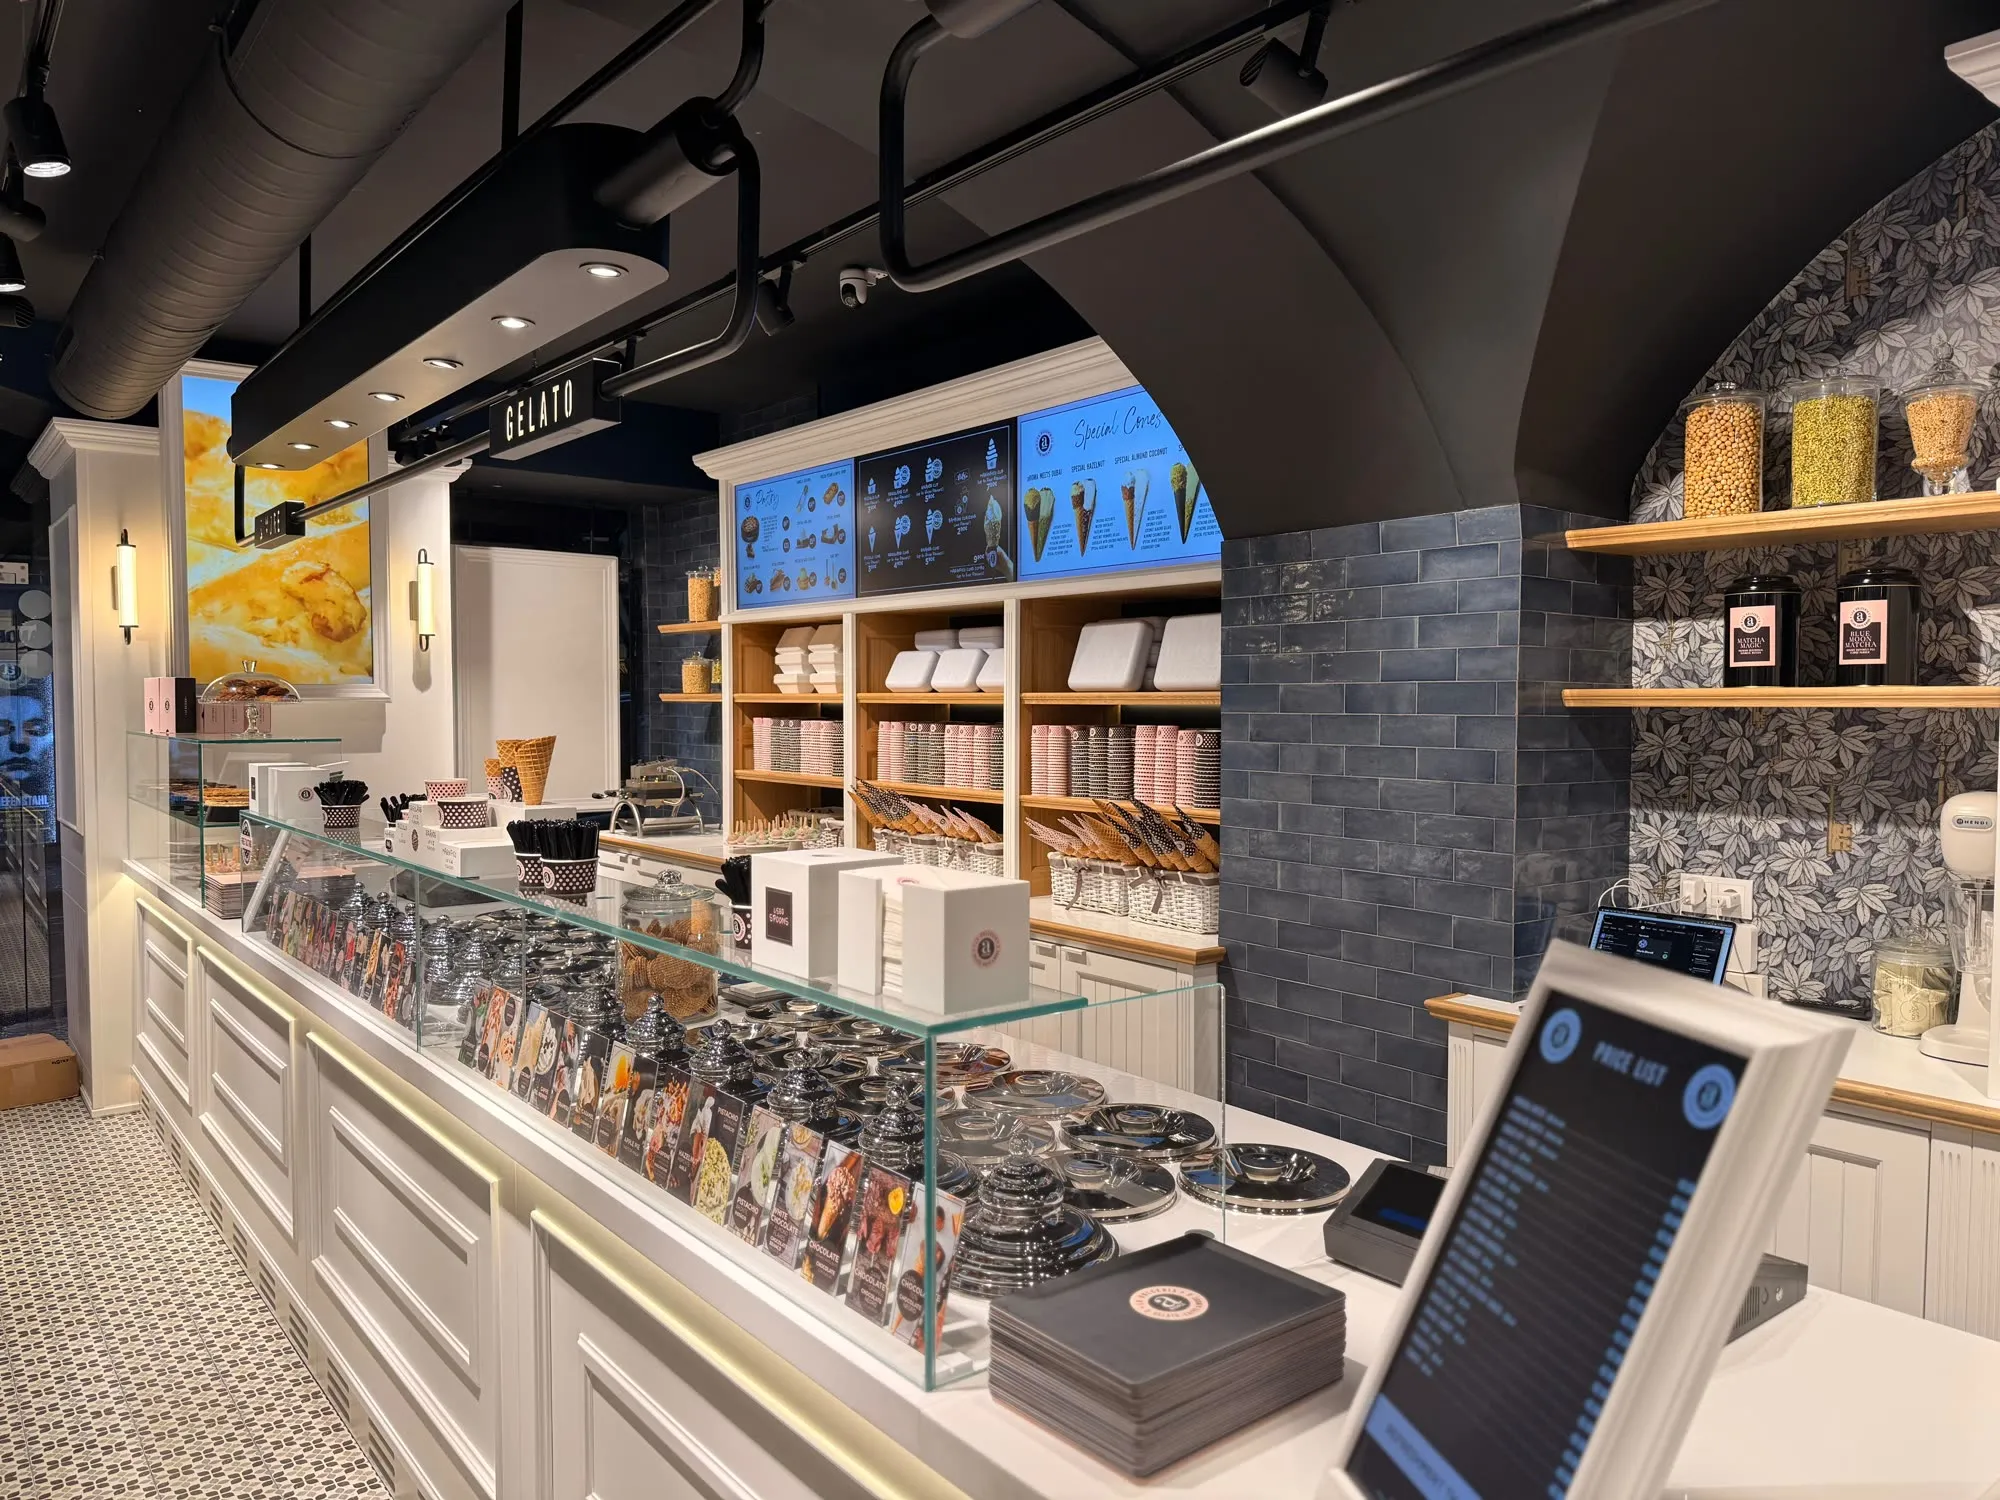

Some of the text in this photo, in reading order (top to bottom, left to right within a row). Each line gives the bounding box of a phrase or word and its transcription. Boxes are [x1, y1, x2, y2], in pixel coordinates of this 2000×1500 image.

[506, 379, 573, 441] GELATO
[1073, 405, 1162, 450] Special Cones
[1071, 460, 1105, 473] SPECIAL HAZELNUT
[1114, 455, 1131, 465] SPECIAL
[1149, 447, 1168, 458] COCONUT
[1592, 1040, 1669, 1088] PRICE LIST
[718, 1106, 738, 1122] PISTACHIO
[736, 1196, 759, 1215] PISTACHIO
[774, 1207, 789, 1221] WHITE
[771, 1214, 799, 1236] CHOCOLATE
[809, 1240, 840, 1263] CHOCOLATE
[855, 1267, 887, 1292] CHOCOLATE
